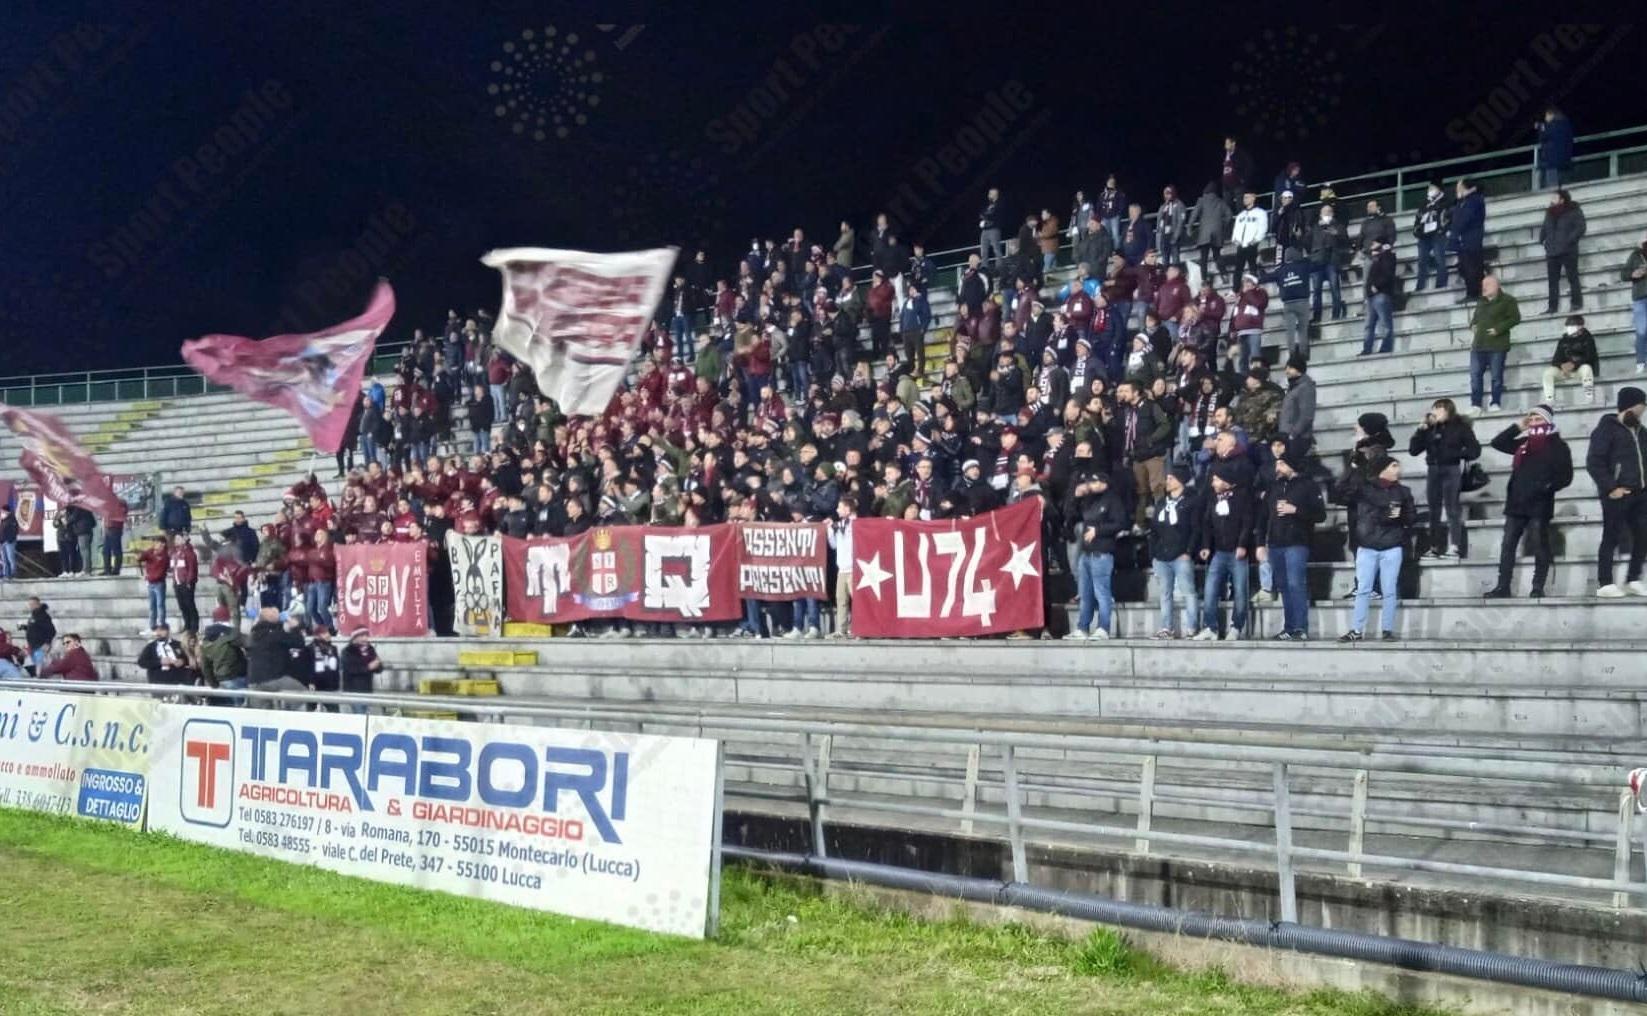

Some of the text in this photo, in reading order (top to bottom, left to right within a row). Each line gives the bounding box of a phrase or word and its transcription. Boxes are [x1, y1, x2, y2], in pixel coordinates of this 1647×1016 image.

[345, 564, 411, 617] G V
[740, 564, 826, 594] PRESENTI
[894, 527, 998, 627] U74
[25, 761, 76, 782] ammollato
[81, 772, 144, 796] INGROSSO &
[241, 725, 629, 845] TARABORI
[86, 797, 140, 821] DETTAGLIO
[239, 783, 584, 841] AGRICOLTURA & GIARDINAGGIO
[254, 810, 278, 827] 0583
[280, 812, 314, 832] 276197
[341, 821, 356, 838] via
[361, 821, 413, 848] Romana,
[416, 829, 441, 848] 170
[453, 835, 495, 857] 55015
[498, 839, 578, 869] Montecarlo
[582, 851, 642, 882] (Lucca)
[256, 831, 279, 849] 0583
[281, 836, 310, 854] 48555
[322, 841, 347, 861] viale
[359, 845, 379, 865] del
[381, 846, 416, 873] Prete,
[419, 855, 444, 874] 347
[456, 860, 498, 884] 55100
[502, 867, 542, 890] Lucca
